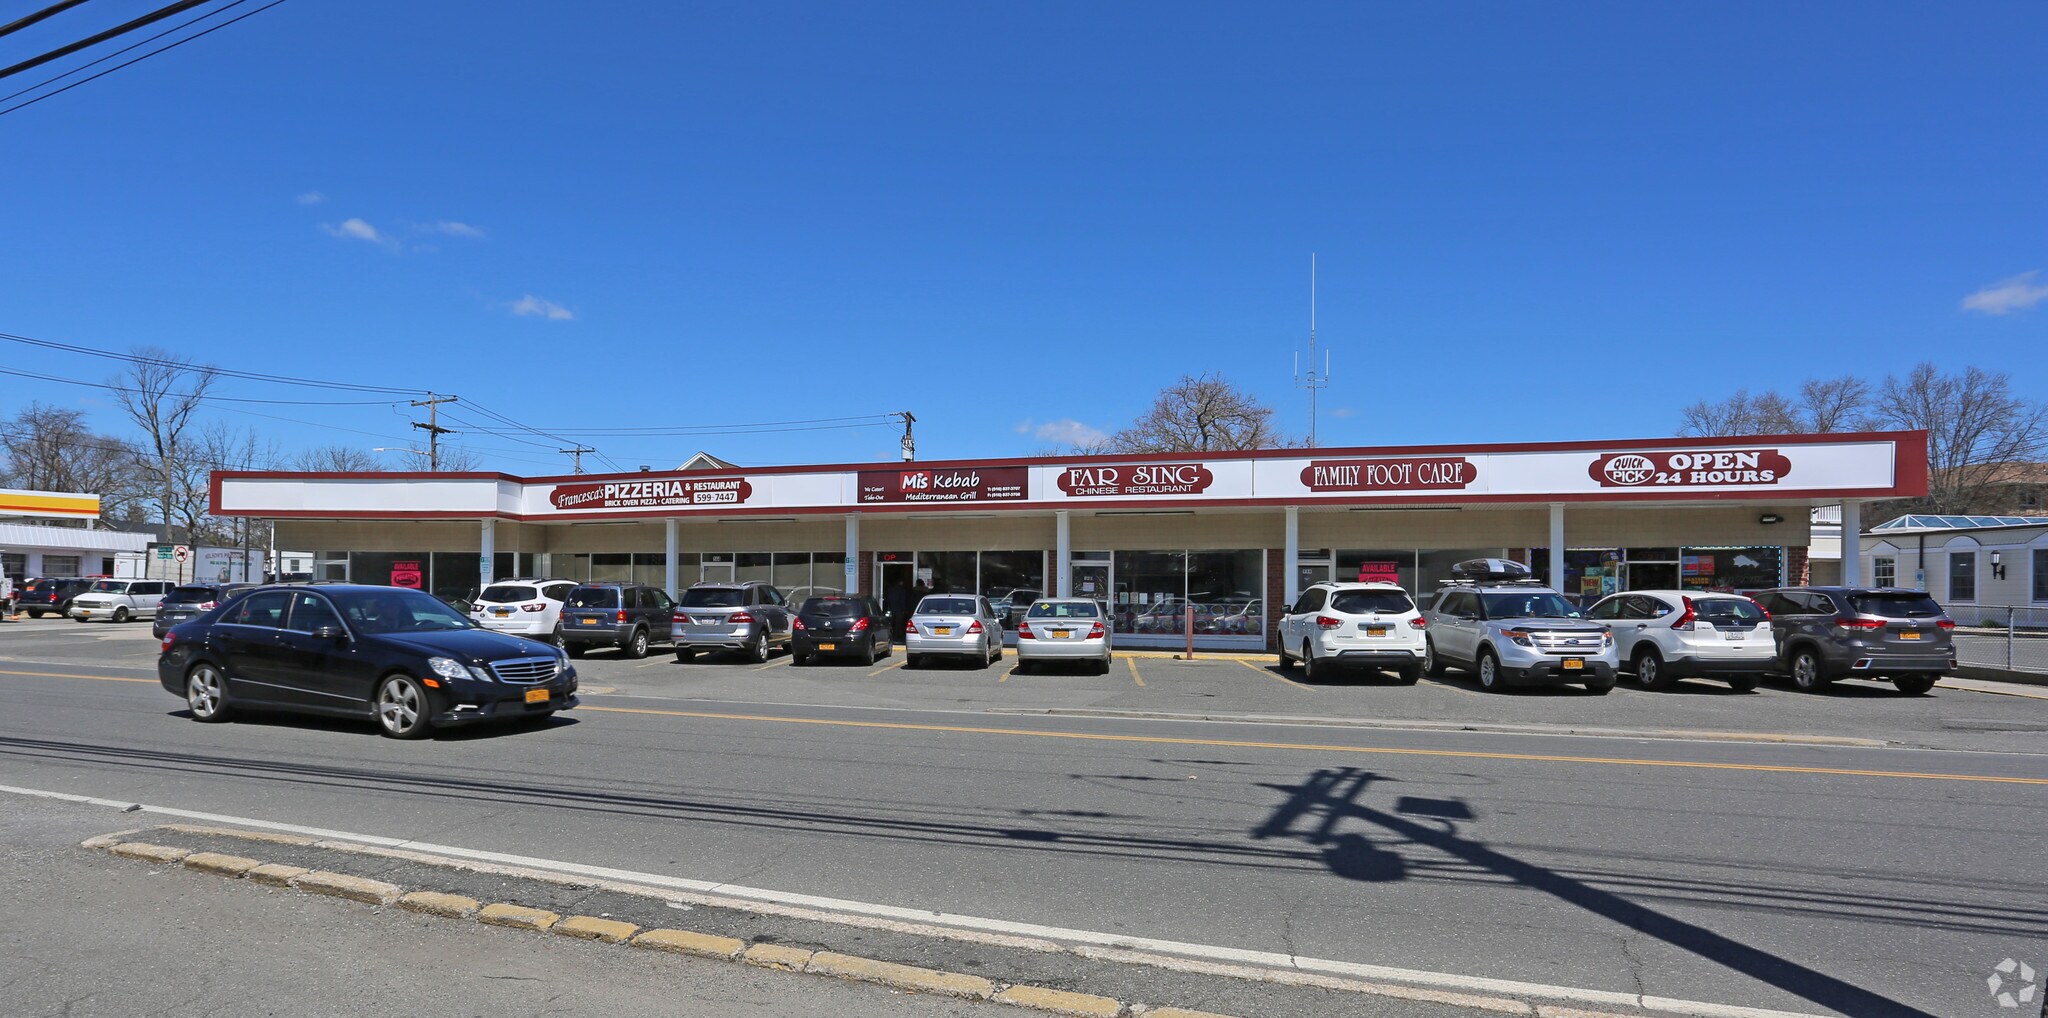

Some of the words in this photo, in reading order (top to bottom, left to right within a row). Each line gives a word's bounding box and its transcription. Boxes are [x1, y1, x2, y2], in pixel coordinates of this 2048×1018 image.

[1614, 458, 1644, 469] QUICK
[1668, 452, 1760, 470] OPEN
[902, 472, 928, 490] Mis
[934, 471, 980, 488] Kebab
[1069, 468, 1120, 486] FAR
[1132, 465, 1200, 485] SING
[1314, 466, 1360, 486] FAMILY
[1367, 463, 1412, 485] FOOT
[1418, 462, 1463, 484] CARE
[1612, 470, 1646, 482] PICK
[1655, 472, 1682, 484] 24
[1690, 470, 1774, 482] HOURS
[604, 482, 684, 499] PIZZERIA
[694, 481, 740, 490] RESTAURANT
[906, 493, 958, 501] Mediterranean
[960, 492, 976, 500] Grill
[1125, 485, 1192, 494] RESTAURANT
[558, 486, 604, 508] Francesca's
[696, 493, 735, 502] 599-7447
[1362, 564, 1395, 572] AVAILABLE
